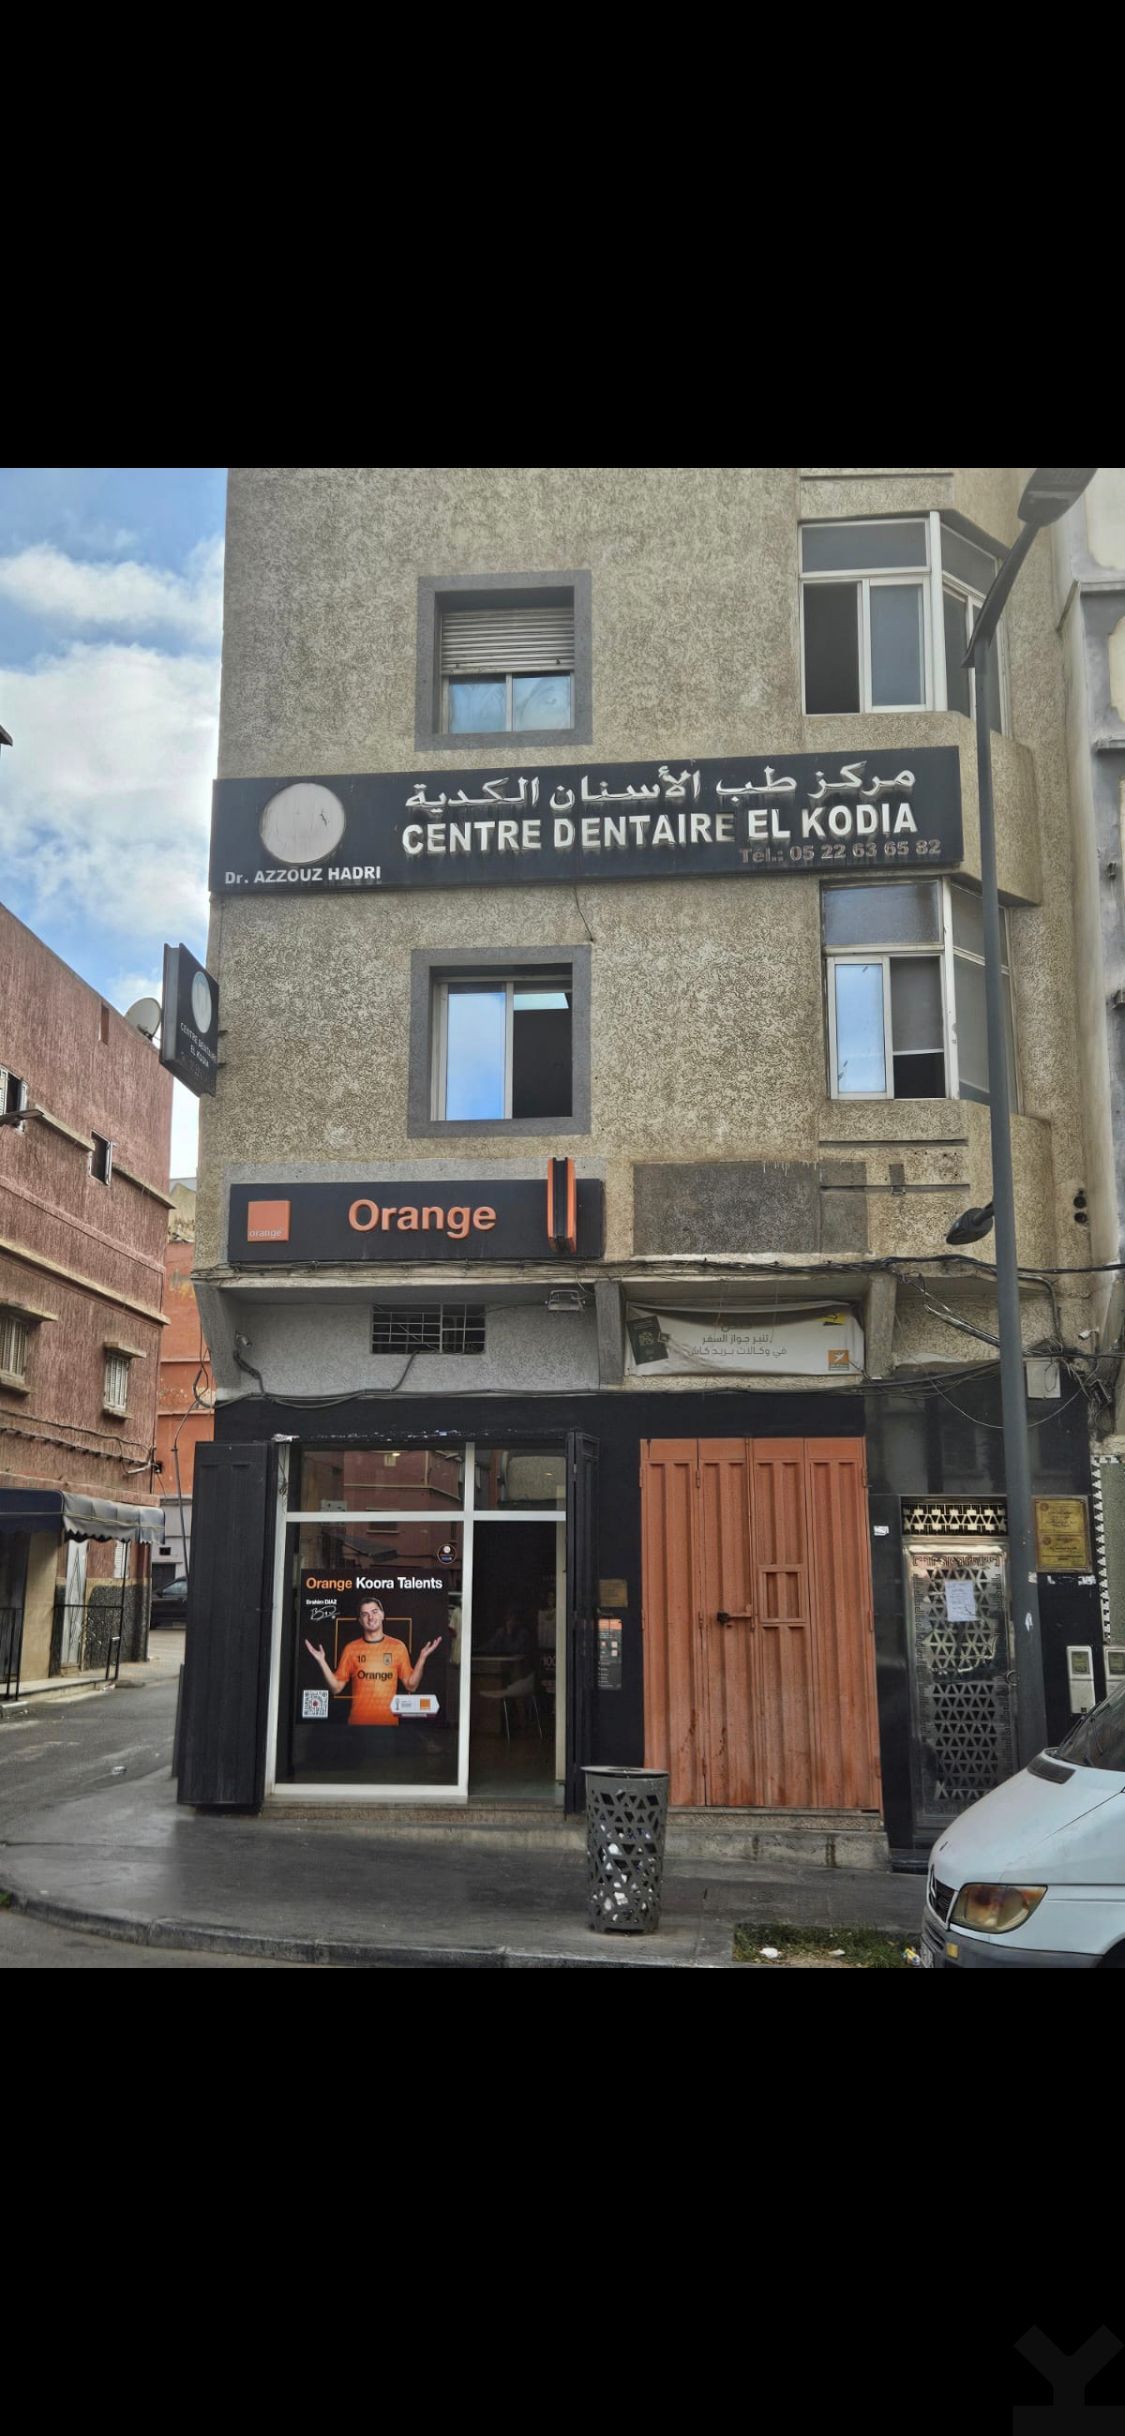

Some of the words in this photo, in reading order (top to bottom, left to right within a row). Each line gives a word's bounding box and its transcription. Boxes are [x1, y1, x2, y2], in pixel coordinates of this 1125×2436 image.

[549, 765, 701, 810] الأسنان
[716, 765, 798, 805] طب
[807, 760, 916, 800] مركز
[404, 775, 540, 814] الكدية
[402, 819, 542, 856] CENTRE
[553, 811, 736, 849] DENTAIRE
[748, 808, 790, 839] EL
[802, 802, 918, 838] KODIA
[790, 843, 815, 862] 05
[821, 843, 846, 860] 22
[853, 841, 878, 858] 63
[884, 840, 909, 857] 65
[916, 839, 942, 856] 82
[225, 870, 248, 885] Dr.
[254, 868, 322, 884] AZZOUZ
[328, 866, 382, 882] HADRI
[348, 1198, 497, 1240] Orange
[249, 1229, 281, 1239] orange
[702, 1333, 728, 1345] السفر
[730, 1333, 750, 1345] جواز
[306, 1577, 353, 1591] Orange
[356, 1577, 395, 1589] Koora
[397, 1576, 443, 1589] Talents
[357, 1655, 366, 1663] 10
[357, 1671, 393, 1682] Orange
